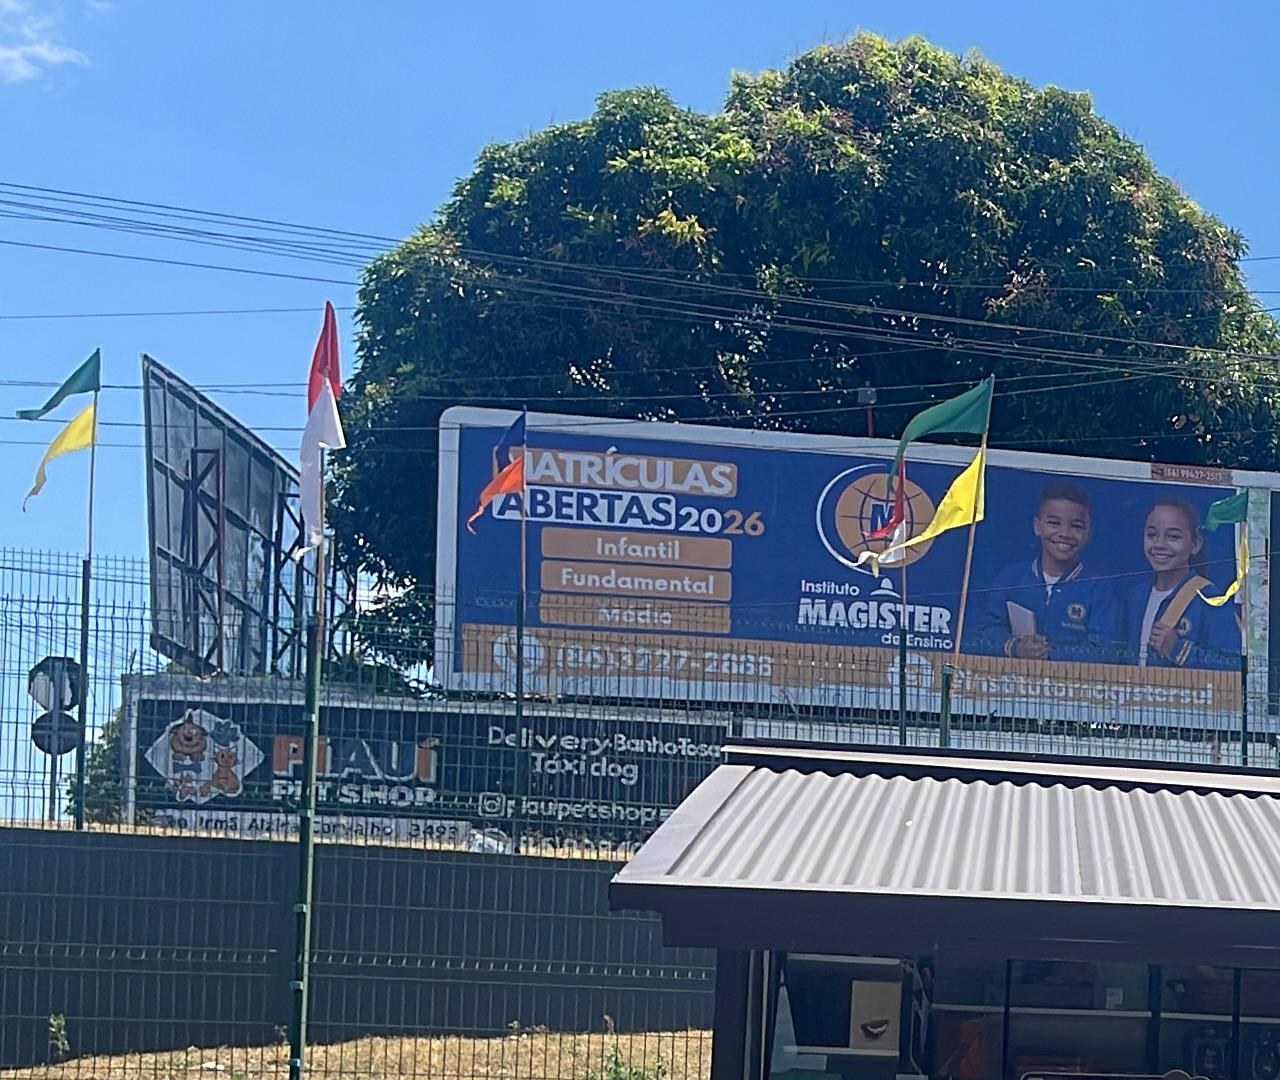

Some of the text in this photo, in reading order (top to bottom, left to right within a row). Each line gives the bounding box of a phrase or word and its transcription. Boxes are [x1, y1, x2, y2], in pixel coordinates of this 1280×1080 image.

[508, 446, 732, 494] ATRÍCULAS
[497, 488, 765, 536] ABERTAS 2026
[596, 537, 680, 560] Infantil
[561, 568, 714, 595] Fundamental
[801, 579, 860, 596] Instituto
[798, 598, 951, 634] MAGISTER
[906, 634, 953, 649] Ensino
[590, 757, 639, 786] dog
[337, 783, 437, 808] SHOP
